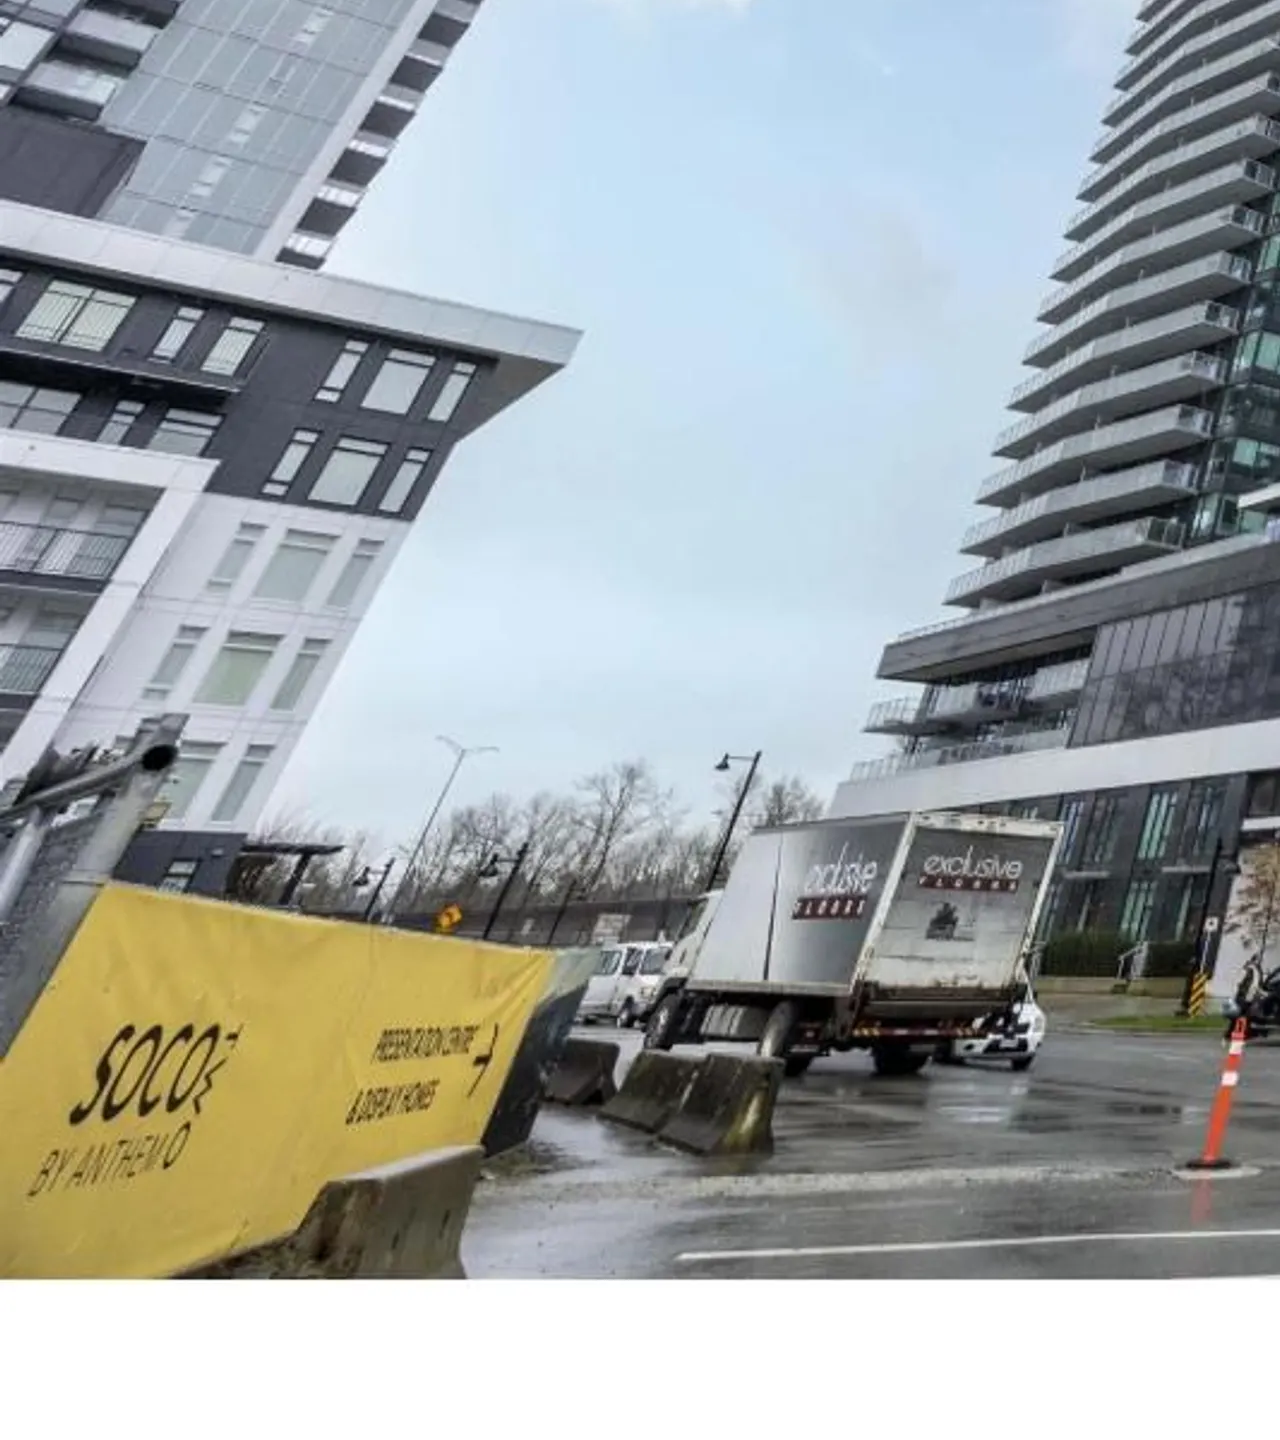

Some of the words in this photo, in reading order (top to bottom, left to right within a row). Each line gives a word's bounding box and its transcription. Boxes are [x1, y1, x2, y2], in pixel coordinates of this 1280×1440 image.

[922, 844, 1023, 879] exclusive
[69, 1023, 220, 1127] SOCO
[27, 1148, 78, 1197] BY
